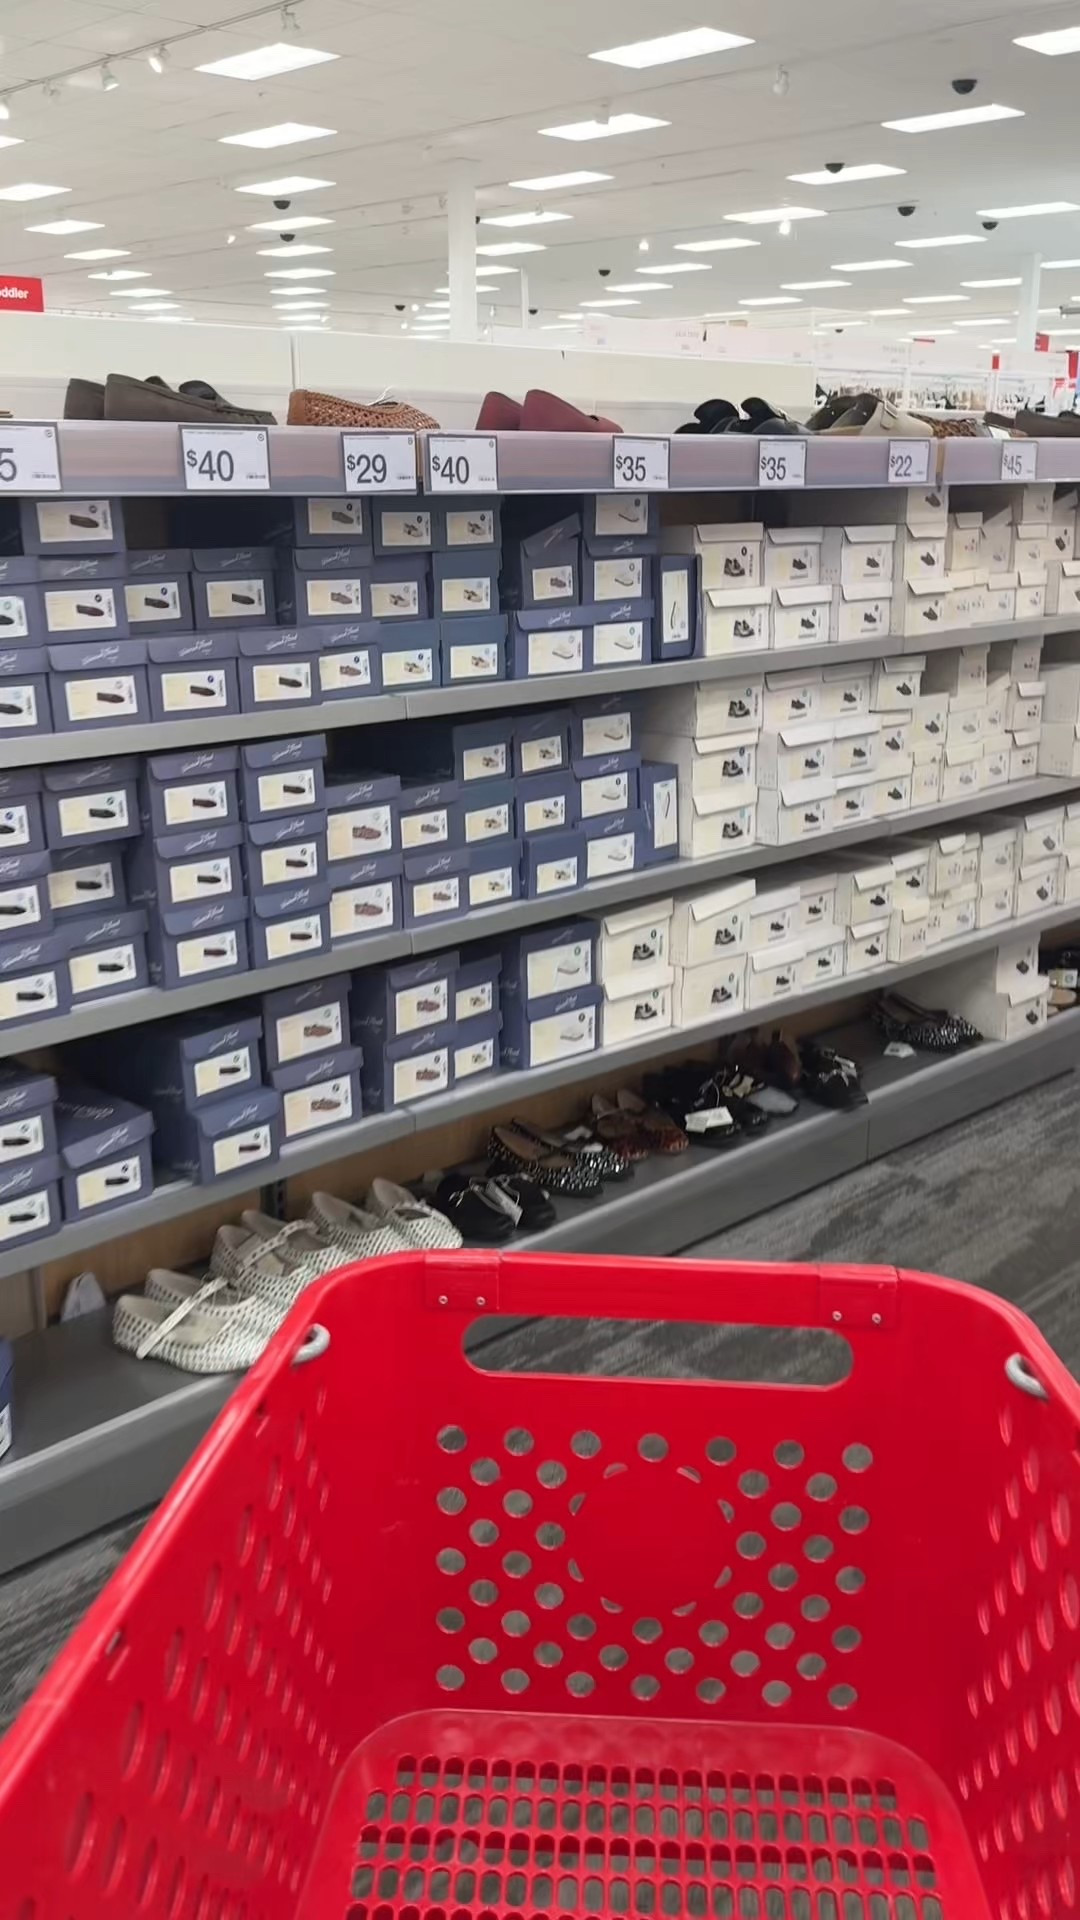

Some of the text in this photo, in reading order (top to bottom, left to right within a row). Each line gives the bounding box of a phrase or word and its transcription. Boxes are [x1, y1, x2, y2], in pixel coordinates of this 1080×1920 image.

[0, 286, 29, 299] ddler
[186, 449, 234, 481] $40
[347, 454, 387, 483] $29
[432, 454, 470, 484] $40
[616, 454, 646, 481] $35
[760, 456, 786, 480] $35
[890, 455, 912, 477] $22
[1003, 454, 1022, 475] $45
